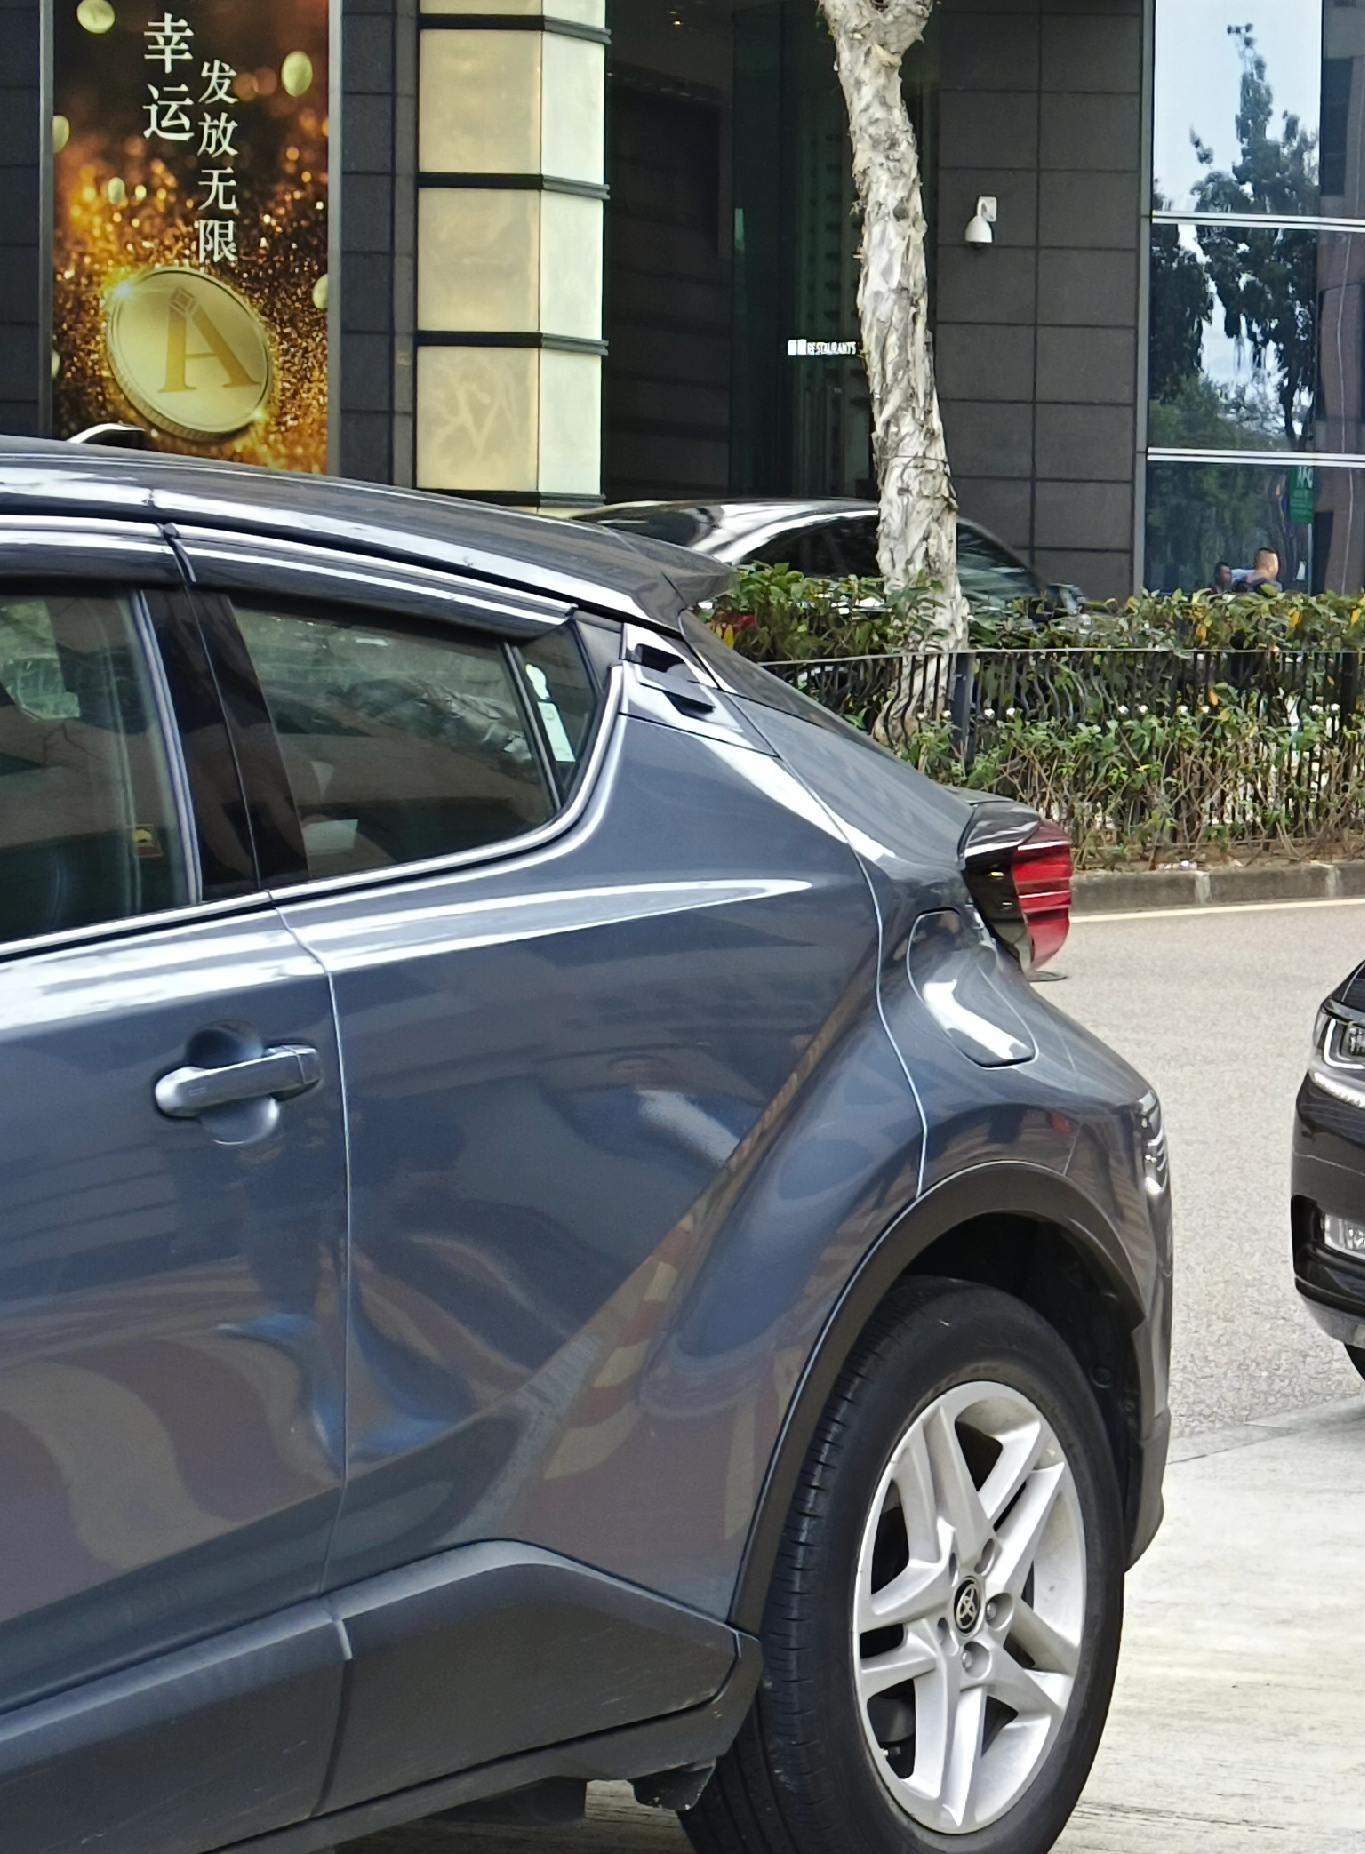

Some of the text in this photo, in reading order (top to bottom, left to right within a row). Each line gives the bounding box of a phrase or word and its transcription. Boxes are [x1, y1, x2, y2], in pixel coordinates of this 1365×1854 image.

[143, 12, 195, 141] 幸运
[197, 59, 239, 263] 发放无限
